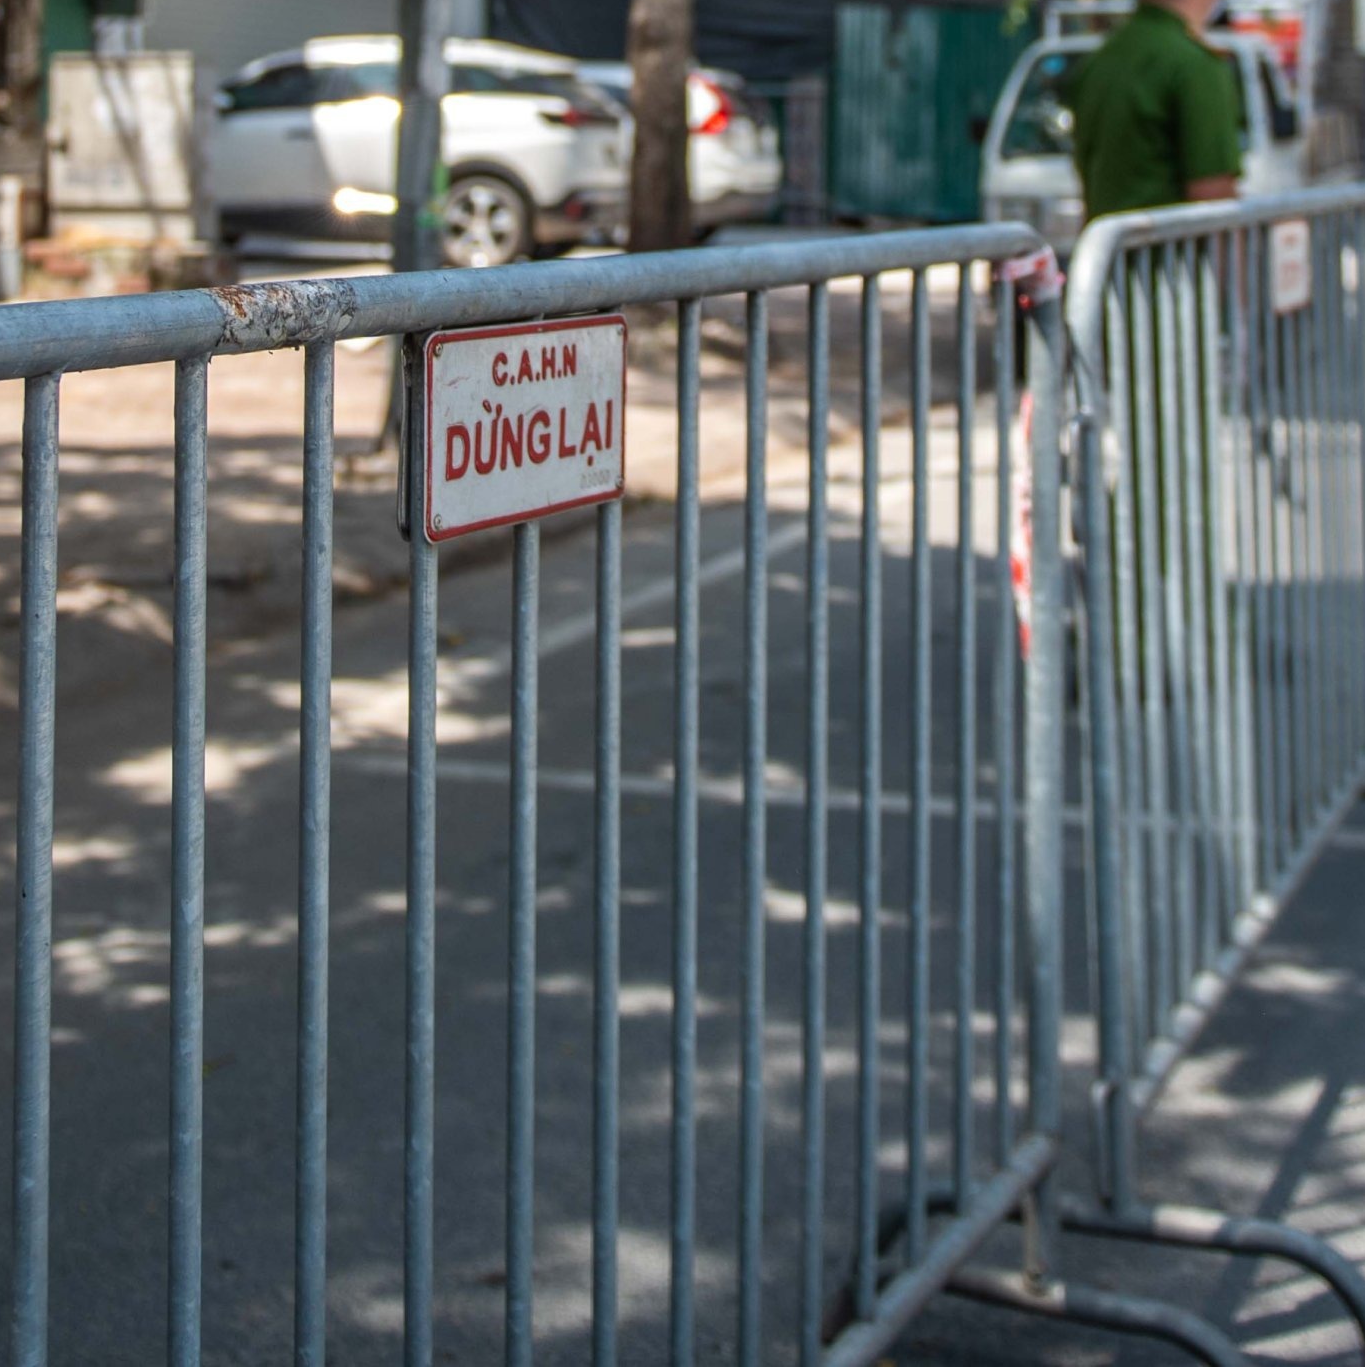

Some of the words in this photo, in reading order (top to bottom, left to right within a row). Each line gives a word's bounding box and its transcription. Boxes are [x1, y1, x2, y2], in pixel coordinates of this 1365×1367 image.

[492, 344, 577, 387] C.A.H.N
[445, 399, 551, 482] DỪNG
[558, 399, 613, 467] LẠI
